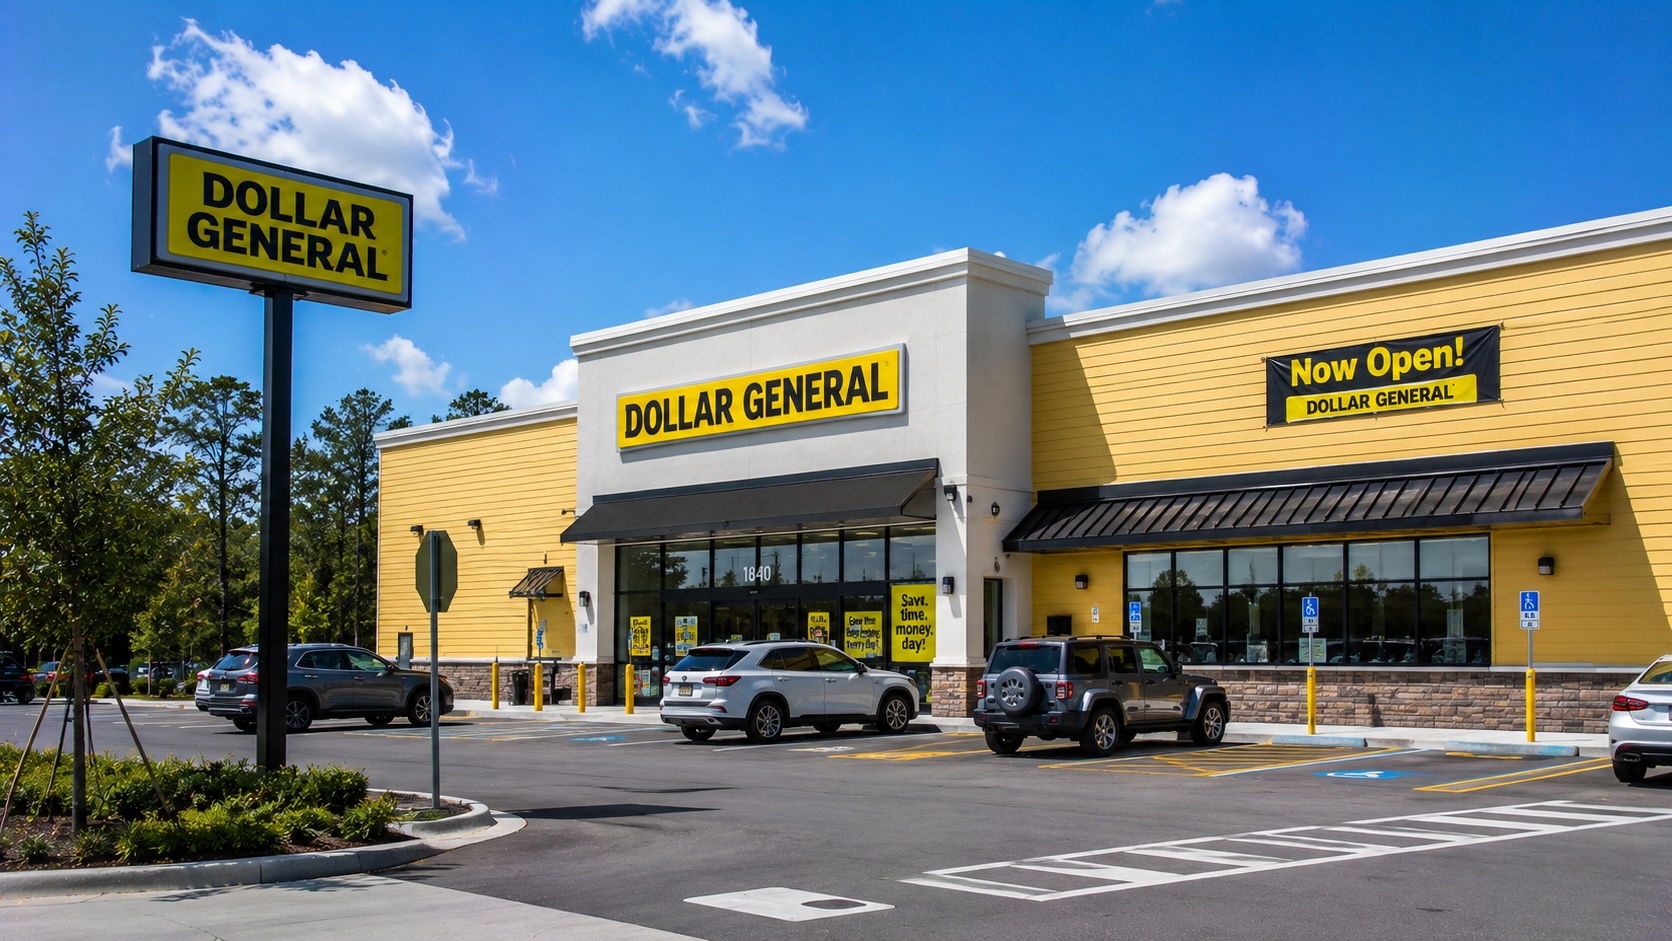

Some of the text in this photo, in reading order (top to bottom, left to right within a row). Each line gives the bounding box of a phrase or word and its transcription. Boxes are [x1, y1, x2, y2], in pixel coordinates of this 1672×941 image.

[203, 172, 376, 240] DOLLAR
[187, 212, 388, 281] GENERAL
[1291, 336, 1464, 387] Now Open!
[625, 362, 889, 439] DOLLAR GENERAL
[1307, 384, 1454, 415] DOLLAR GENERAL
[743, 565, 771, 582] 1840
[900, 608, 928, 621] time.
[896, 624, 933, 638] money.
[902, 636, 926, 654] day!
